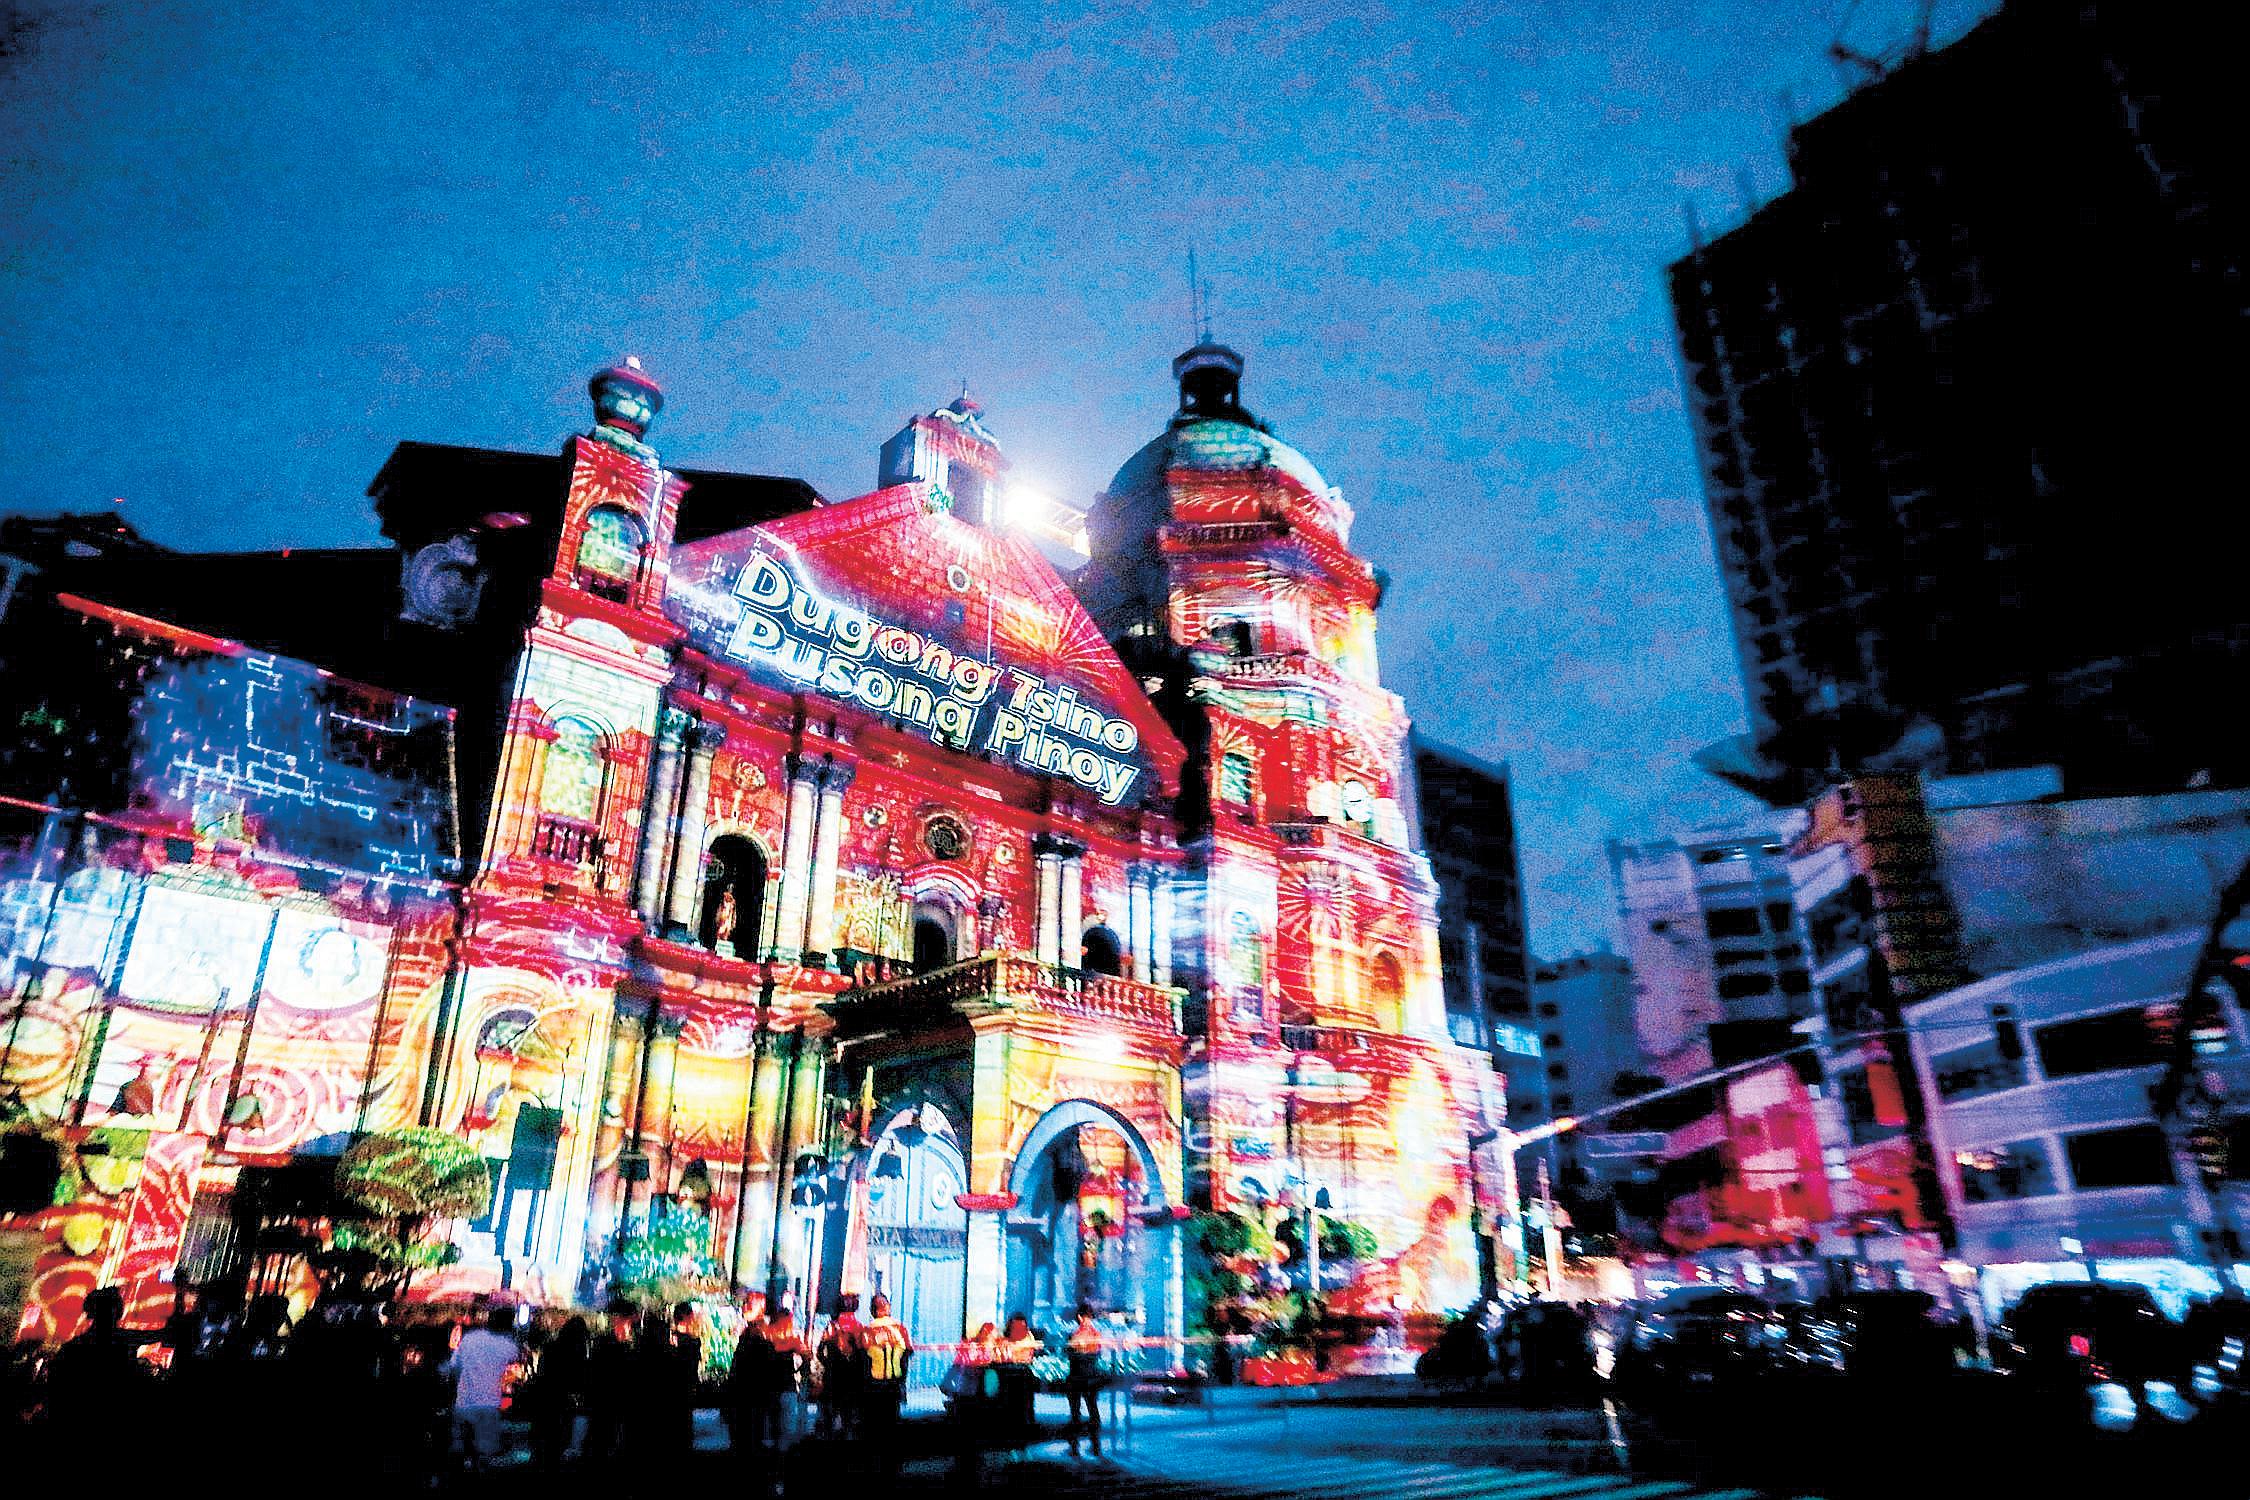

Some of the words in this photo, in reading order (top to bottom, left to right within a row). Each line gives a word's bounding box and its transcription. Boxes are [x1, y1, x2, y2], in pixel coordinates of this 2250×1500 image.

[725, 605, 980, 750] Pusong
[984, 706, 1141, 806] Pinoy
[732, 549, 1002, 706] Dugong
[1008, 666, 1138, 753] Tsino
[867, 1226, 904, 1248] RIA
